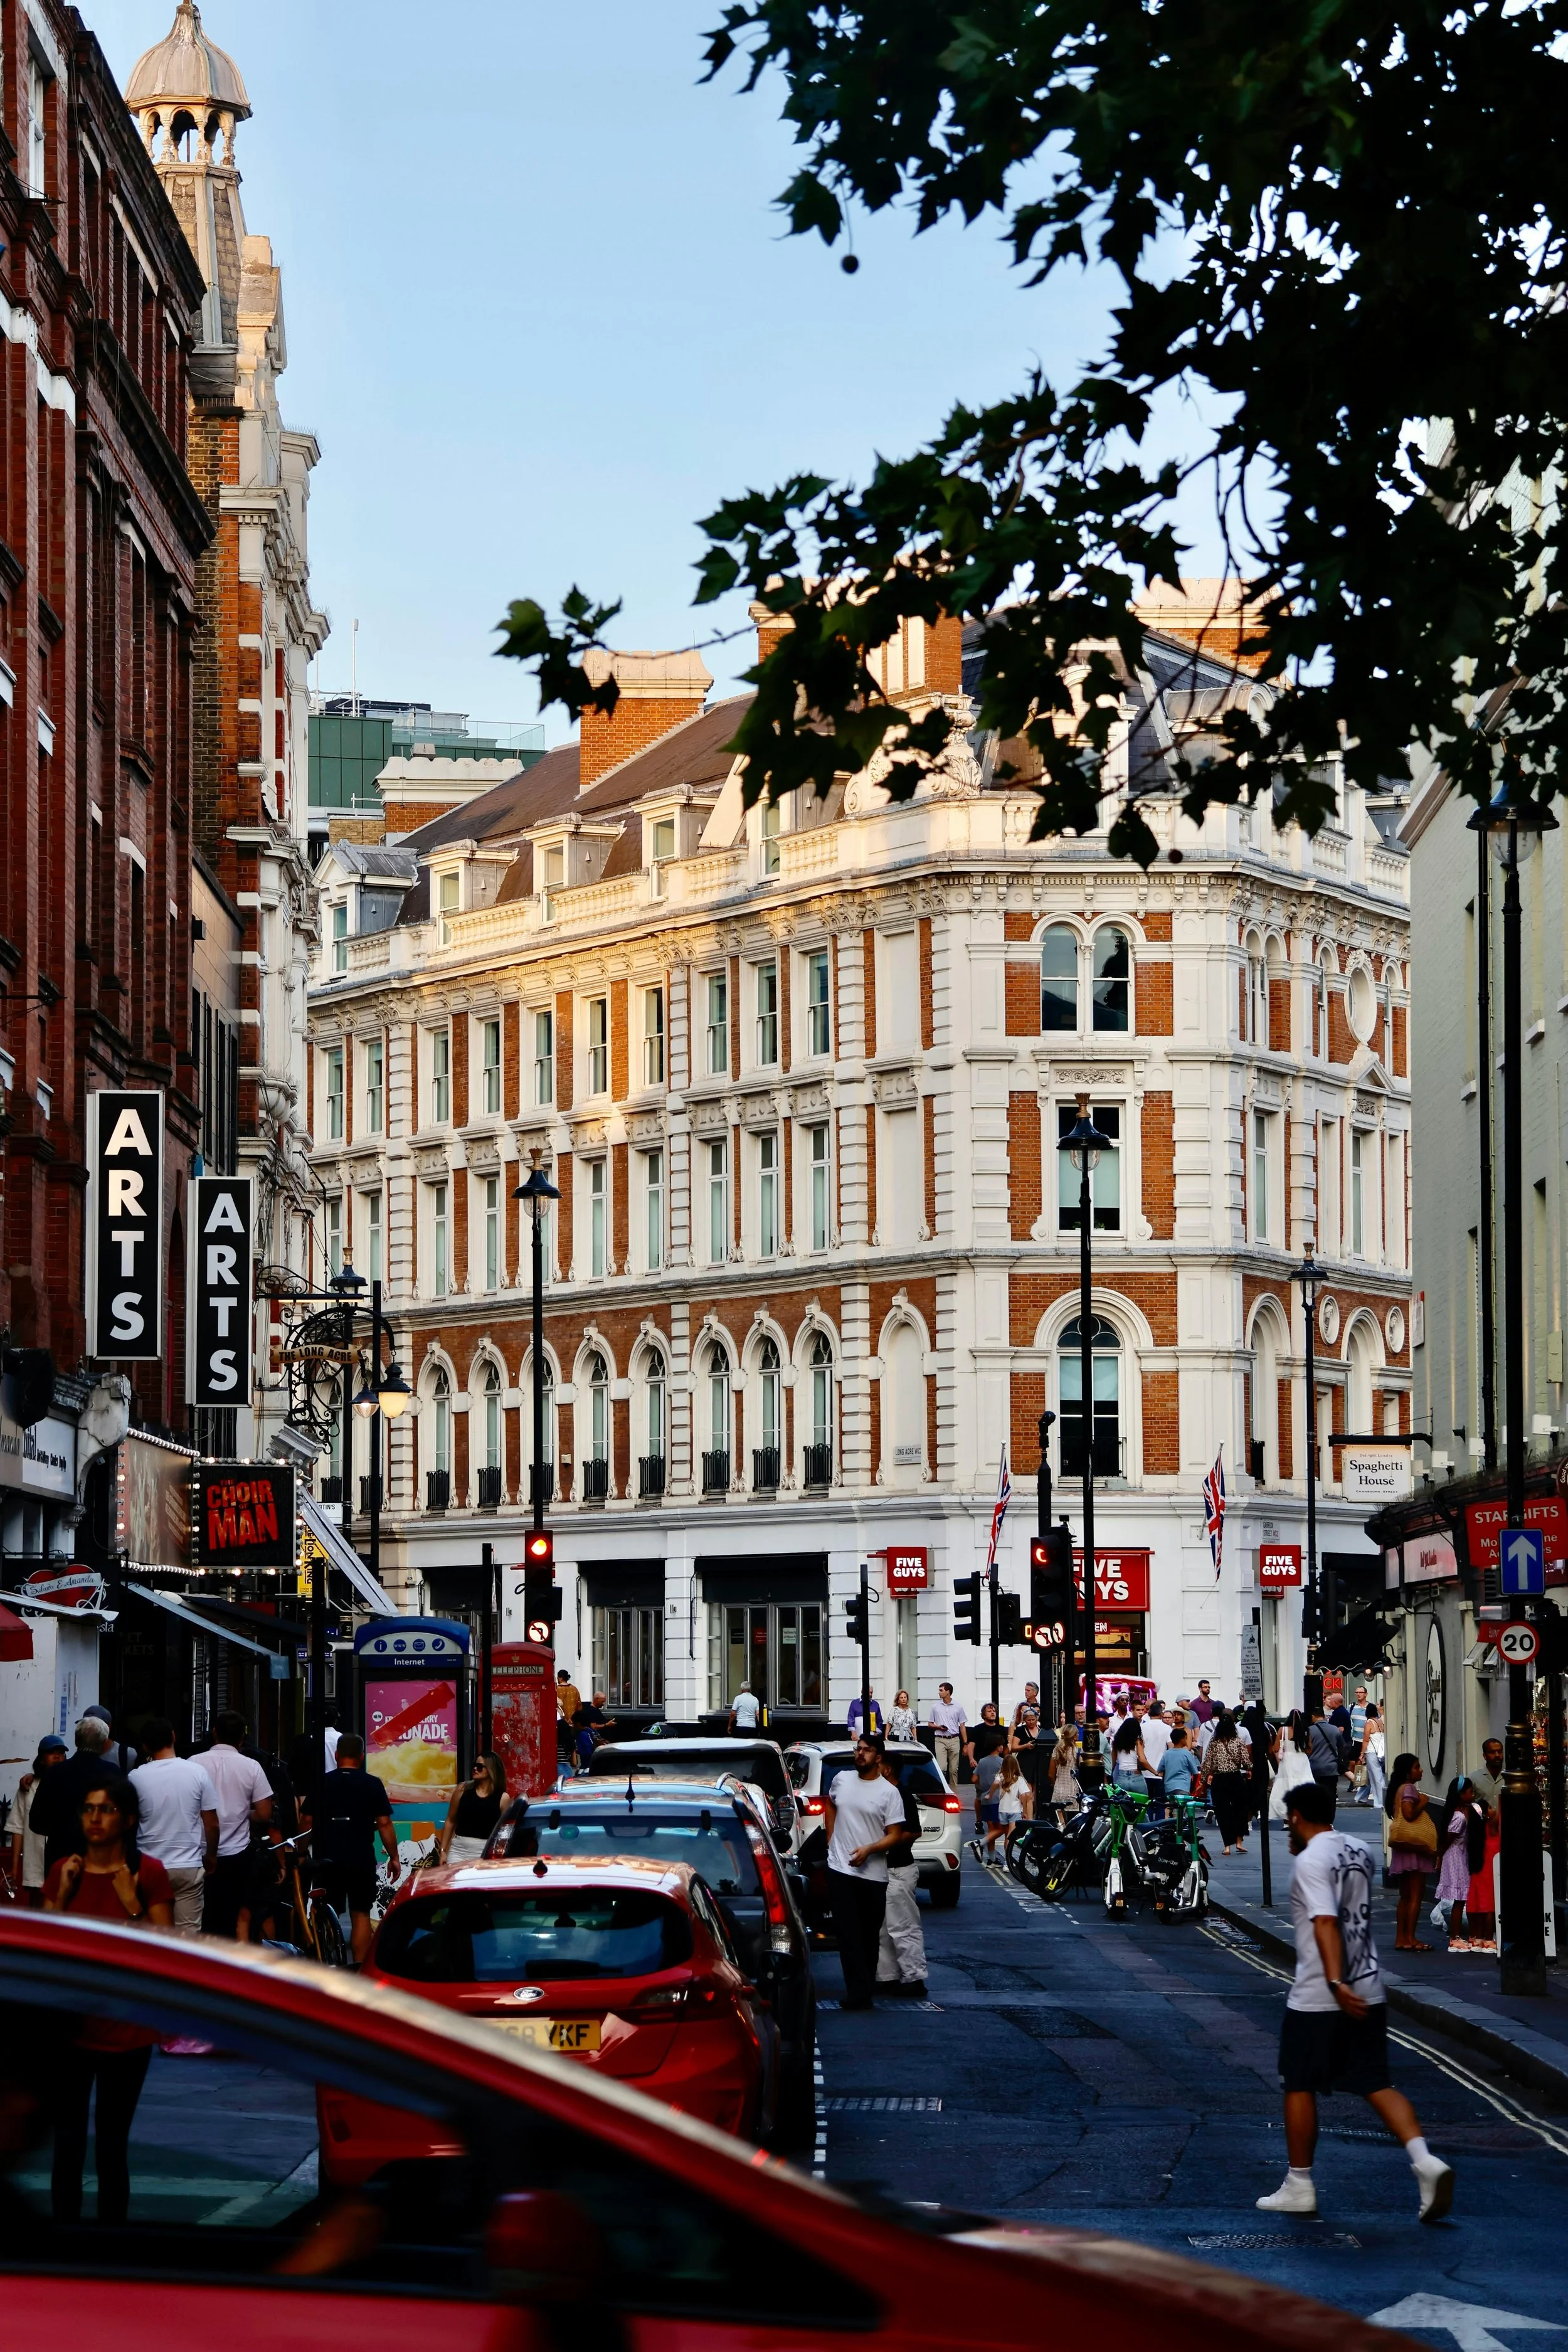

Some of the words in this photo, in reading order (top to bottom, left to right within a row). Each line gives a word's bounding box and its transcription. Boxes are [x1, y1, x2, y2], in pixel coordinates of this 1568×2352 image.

[104, 1109, 152, 1340] ARTS
[204, 1193, 245, 1391] ARTS
[279, 1352, 296, 1361] THE
[299, 1347, 324, 1357] LONG
[327, 1349, 351, 1361] ACRE
[1350, 1459, 1403, 1473] Spaghetti
[1359, 1476, 1394, 1485] House
[206, 1480, 273, 1508] CHOIR
[208, 1503, 278, 1550] MAN
[896, 1557, 922, 1567] FIVE
[1265, 1555, 1293, 1565] FIVE
[893, 1567, 925, 1577] GUYS
[1262, 1565, 1297, 1576] GUYS
[1503, 1634, 1534, 1651] 20
[492, 1665, 542, 1674] TELEPHONE
[544, 2024, 590, 2047] YKF
